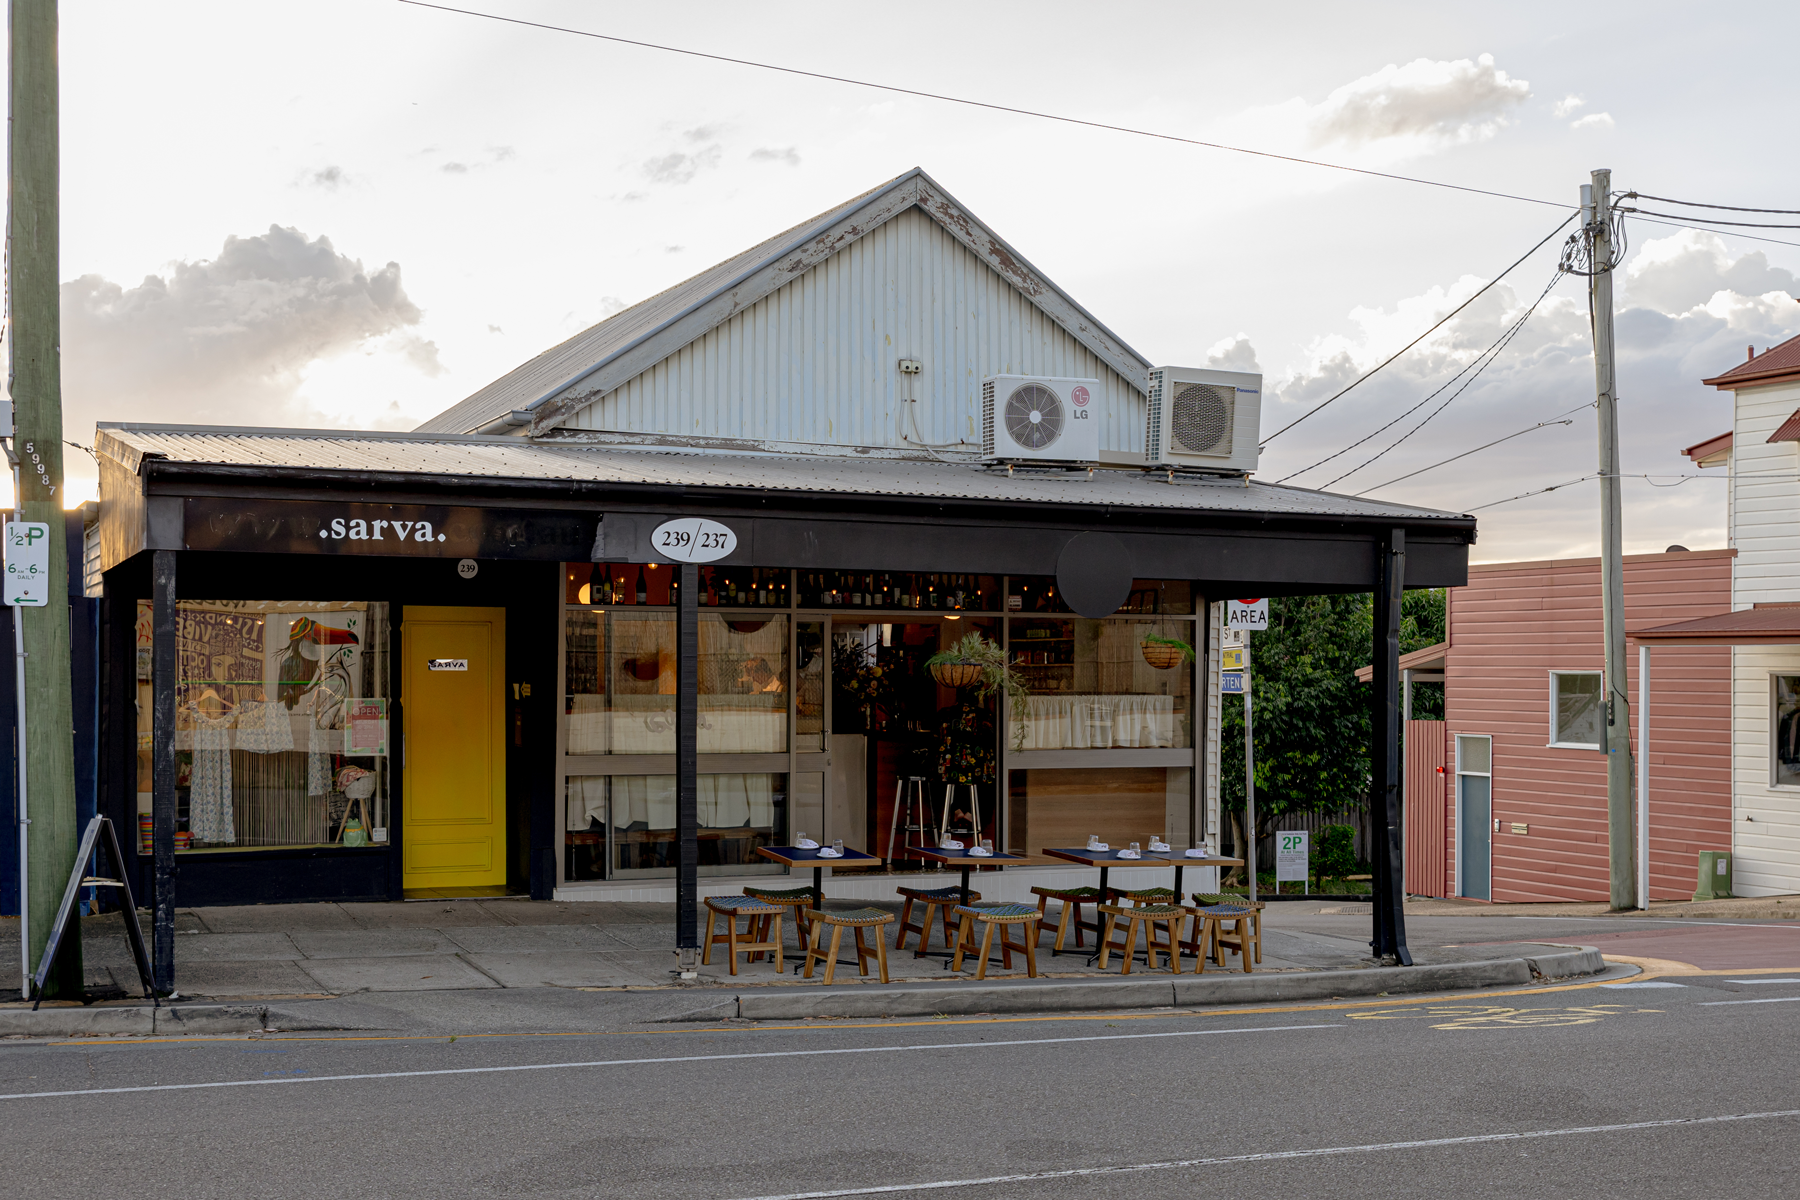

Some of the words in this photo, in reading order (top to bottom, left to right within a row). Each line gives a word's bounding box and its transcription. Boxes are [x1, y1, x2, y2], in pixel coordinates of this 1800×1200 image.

[1073, 409, 1089, 420] LG
[26, 442, 56, 496] 59987
[460, 563, 475, 573] 239
[1230, 609, 1267, 624] AREA
[352, 707, 379, 716] OPEN
[1282, 836, 1303, 850] 2P
